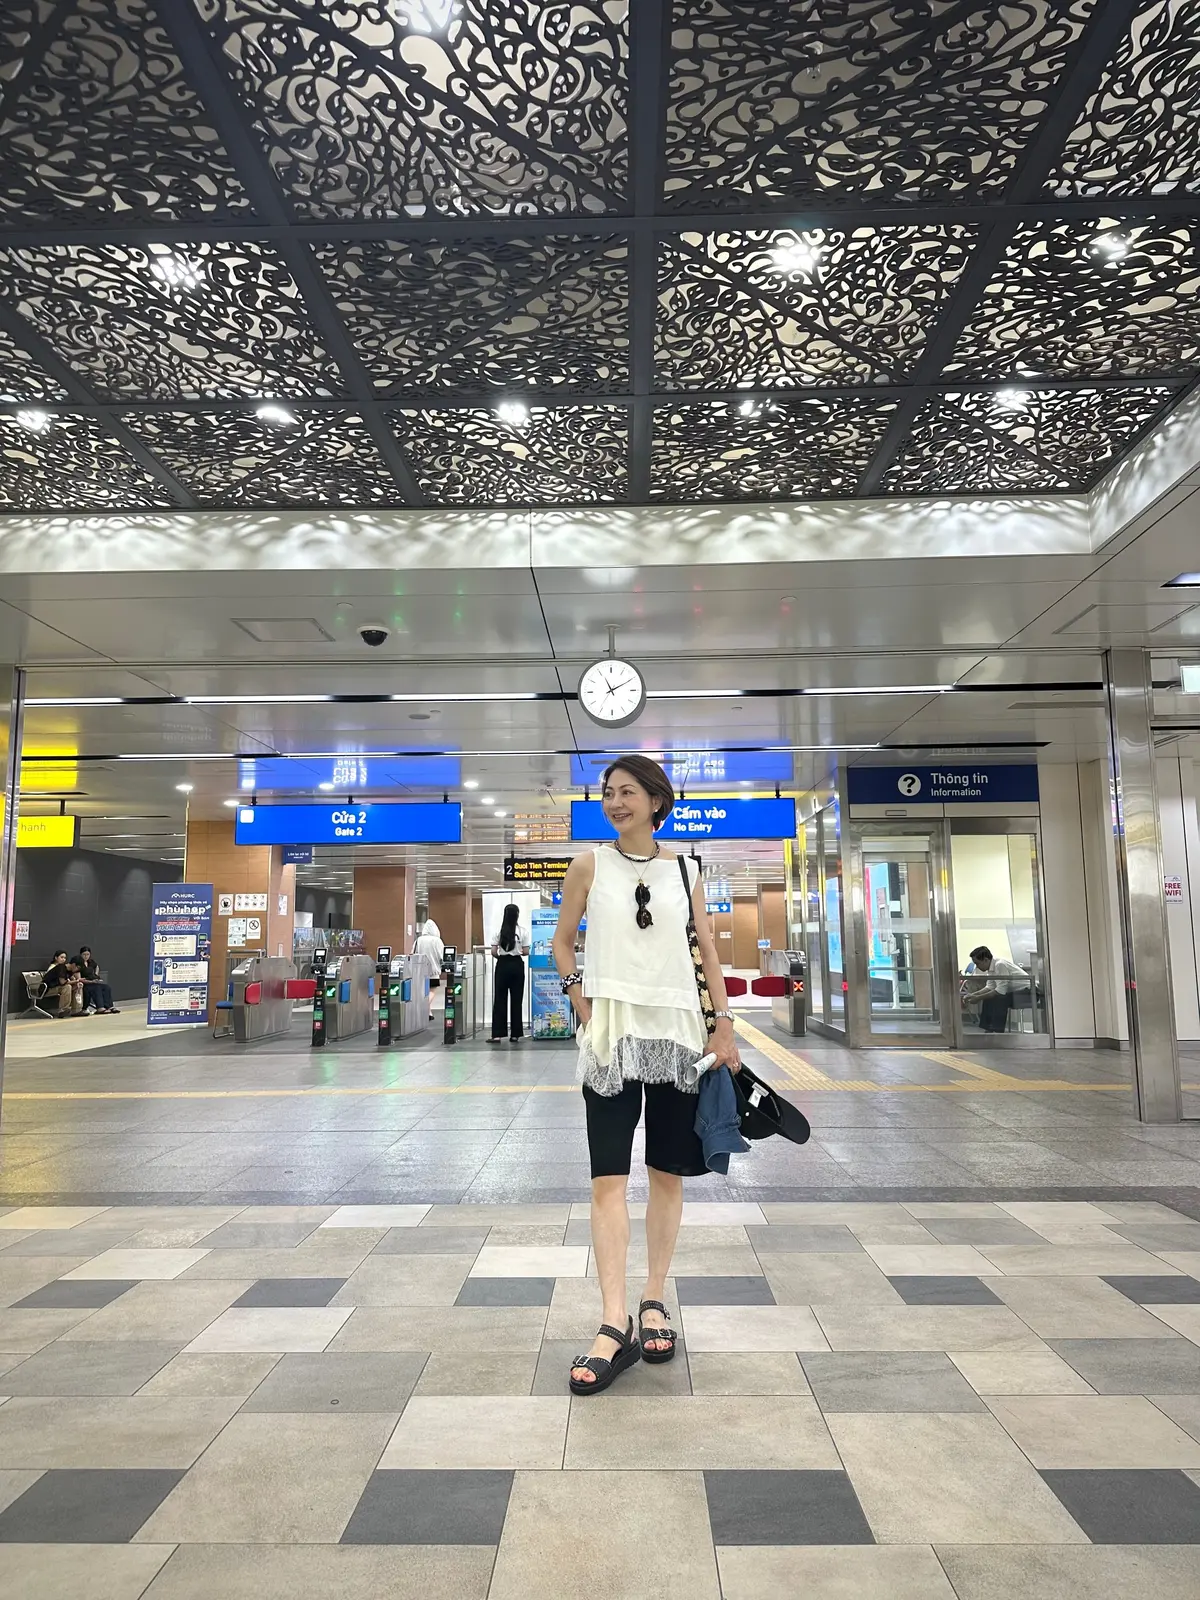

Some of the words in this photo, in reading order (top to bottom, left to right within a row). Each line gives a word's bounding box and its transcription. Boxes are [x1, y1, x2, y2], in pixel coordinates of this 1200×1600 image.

[930, 773, 969, 786] Thông
[973, 773, 988, 783] tin
[931, 788, 981, 796] Information
[332, 810, 355, 824] Cửa
[358, 811, 366, 824] 2
[673, 806, 701, 819] Cấm
[704, 806, 726, 819] vào
[335, 827, 354, 836] Gate
[356, 827, 362, 836] 2
[673, 822, 686, 832] No
[688, 822, 712, 833] Entry
[506, 865, 513, 875] 2
